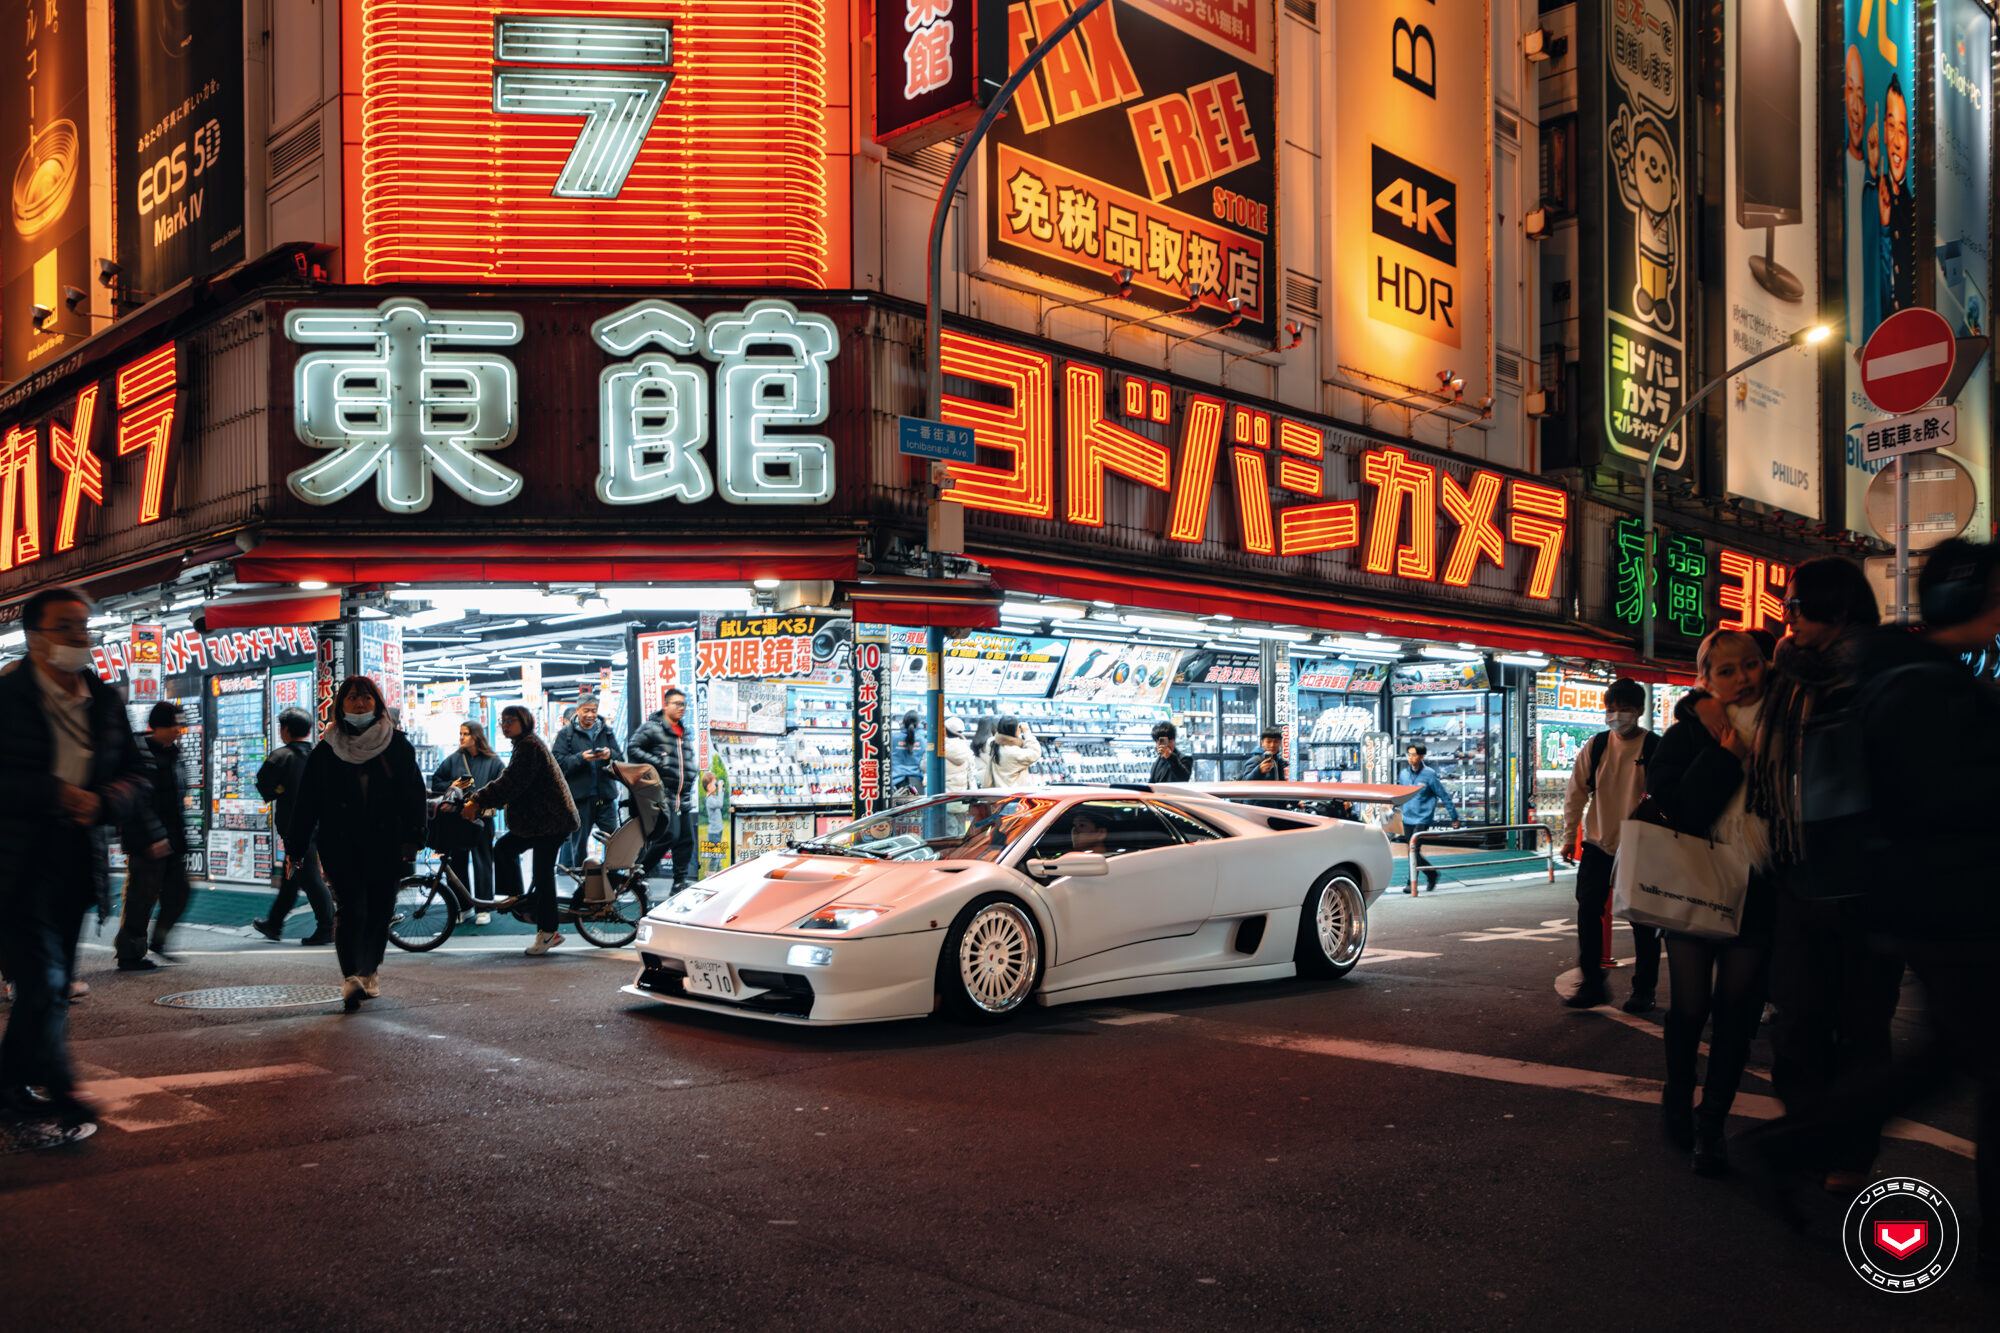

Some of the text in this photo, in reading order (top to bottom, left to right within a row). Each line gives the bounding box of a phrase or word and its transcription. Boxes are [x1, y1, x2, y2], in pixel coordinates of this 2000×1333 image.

[1008, 0, 1144, 135] TAX
[1127, 71, 1261, 203] FREE
[138, 118, 221, 216] EOS 5D
[154, 201, 187, 247] Mark
[190, 188, 204, 223] IV
[1212, 186, 1269, 236] STORE
[1375, 177, 1453, 246] 4K
[1007, 167, 1261, 312] 免税品取扱店
[1377, 256, 1455, 329] HDR
[1611, 333, 1680, 389] ヨドバシ
[284, 297, 841, 513] 東館
[1622, 377, 1671, 424] カメラ
[906, 425, 969, 446] 一番街通り
[906, 440, 969, 458] Ichibangai Ave.
[1867, 417, 1951, 453] 自転車を除く
[940, 328, 1568, 600] ヨドバシカメラ
[1772, 460, 1810, 491] PHILIPS
[1616, 517, 1706, 637] 家電
[1719, 548, 1794, 633] ヨド
[205, 625, 317, 667] マルチメディア館
[658, 639, 676, 656] 最短
[720, 616, 816, 638] 試して選べる!
[697, 637, 795, 677] 双眼鏡
[796, 637, 812, 672] 売場
[276, 679, 298, 703] 相談
[1297, 673, 1349, 690] 大口径双眼鏡
[1394, 680, 1459, 692] フィールドスコープ
[753, 833, 797, 847] おすすめ
